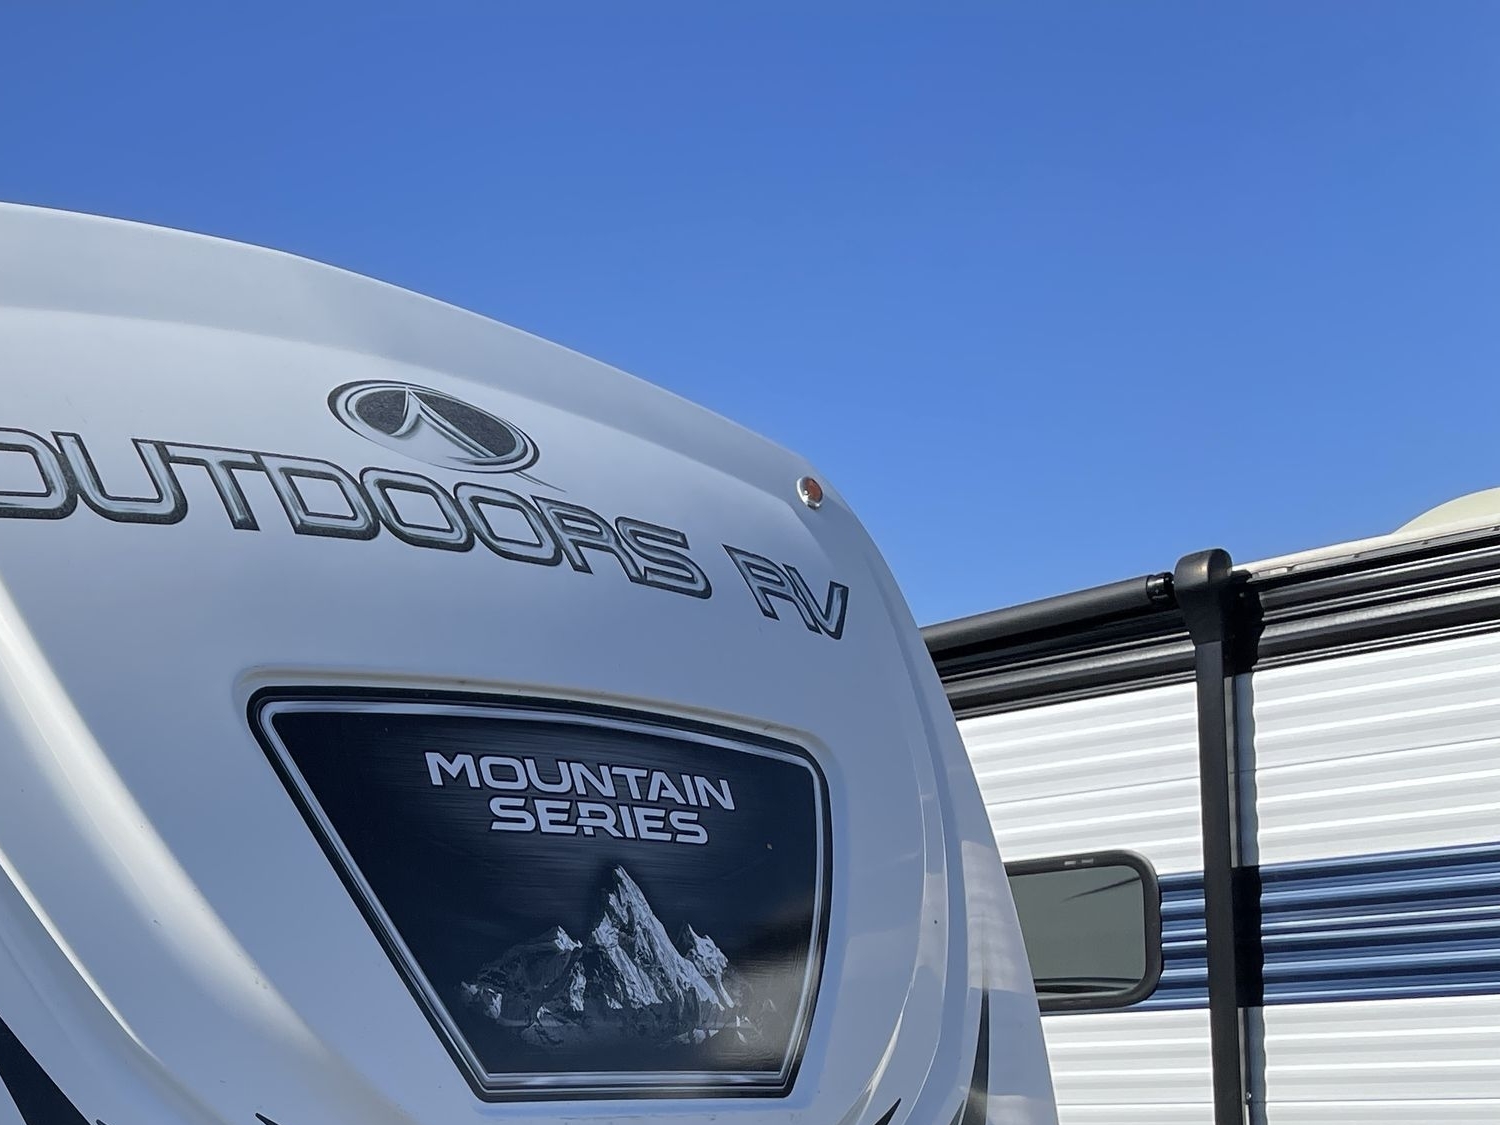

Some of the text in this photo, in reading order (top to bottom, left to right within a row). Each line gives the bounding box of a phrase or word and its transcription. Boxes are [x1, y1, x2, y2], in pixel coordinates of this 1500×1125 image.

[722, 543, 851, 641] RV
[423, 751, 736, 811] MOUNTAIN
[488, 796, 709, 845] SERIES
